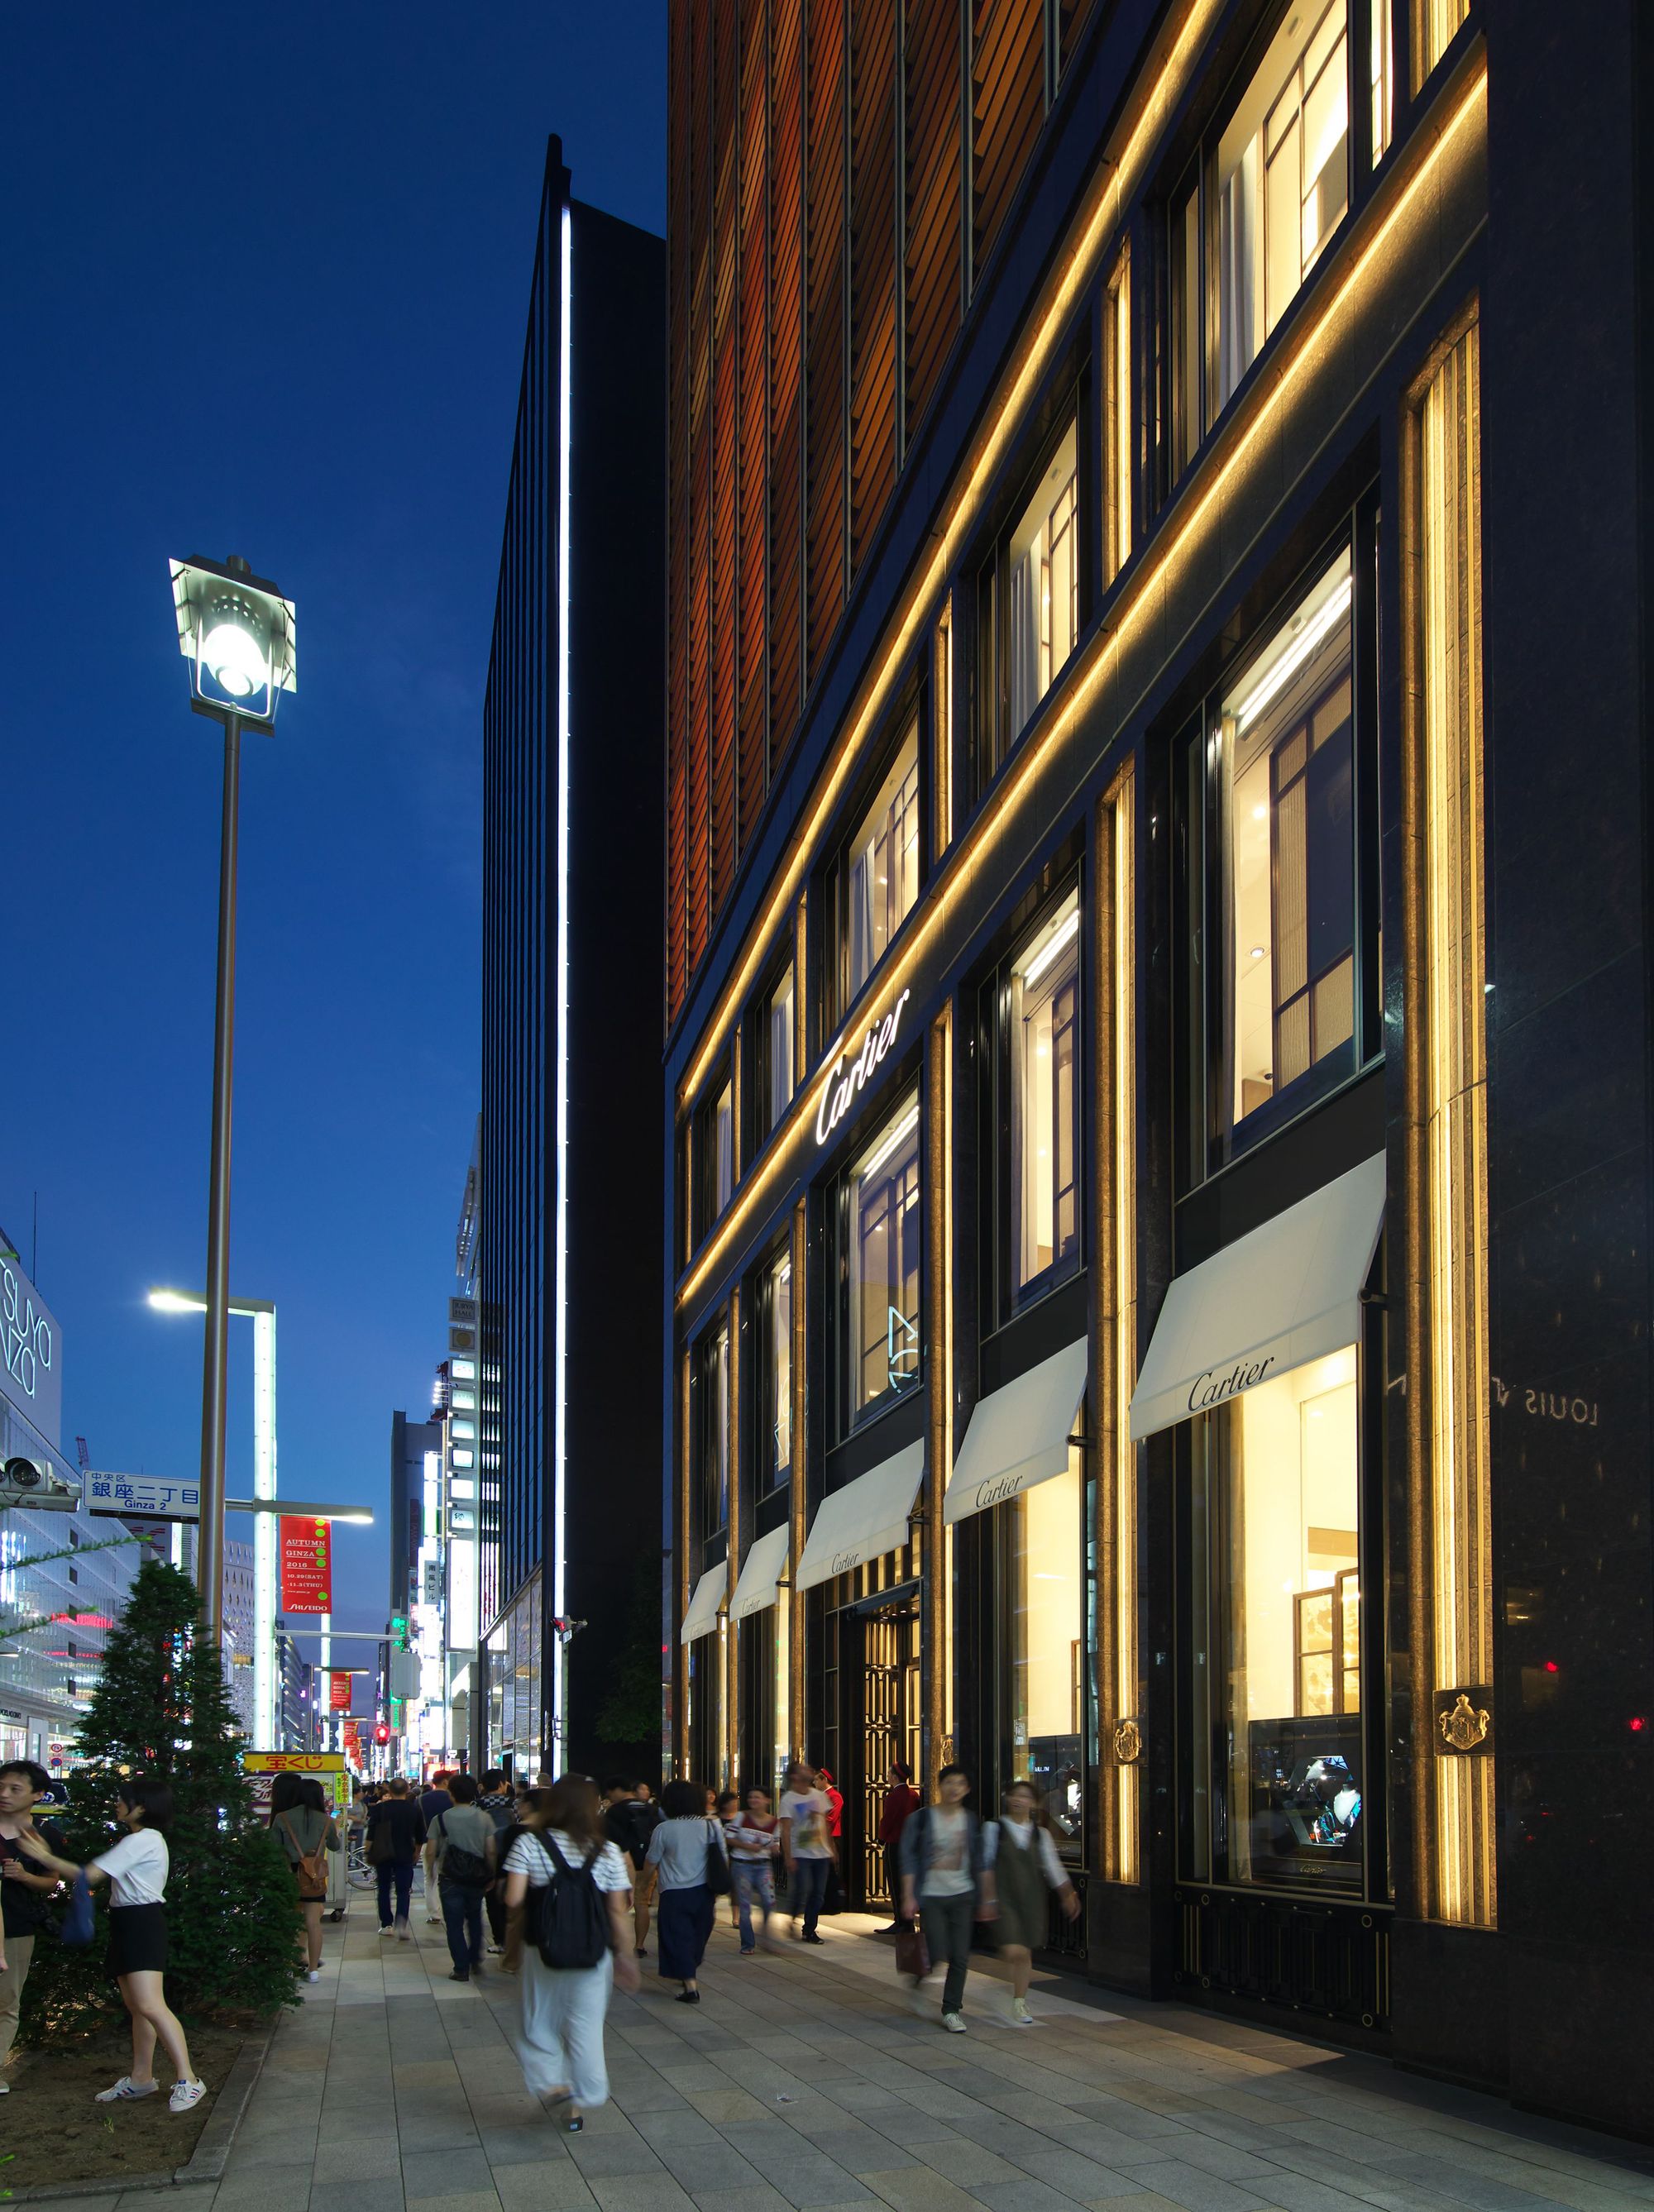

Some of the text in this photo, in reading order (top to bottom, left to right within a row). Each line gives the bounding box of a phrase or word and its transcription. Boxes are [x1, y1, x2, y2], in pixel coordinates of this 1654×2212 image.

[816, 988, 911, 1146] Cartier
[1188, 1356, 1275, 1412] Cartier
[92, 1473, 126, 1483] 中央区
[92, 1481, 198, 1504] 銀座二丁目
[976, 1475, 1023, 1507] Cartier
[124, 1499, 166, 1511] Ginza 2
[832, 1553, 859, 1574] Cartier
[287, 1603, 327, 1612] SHISEIDO
[266, 1756, 323, 1770] 宝くじ
